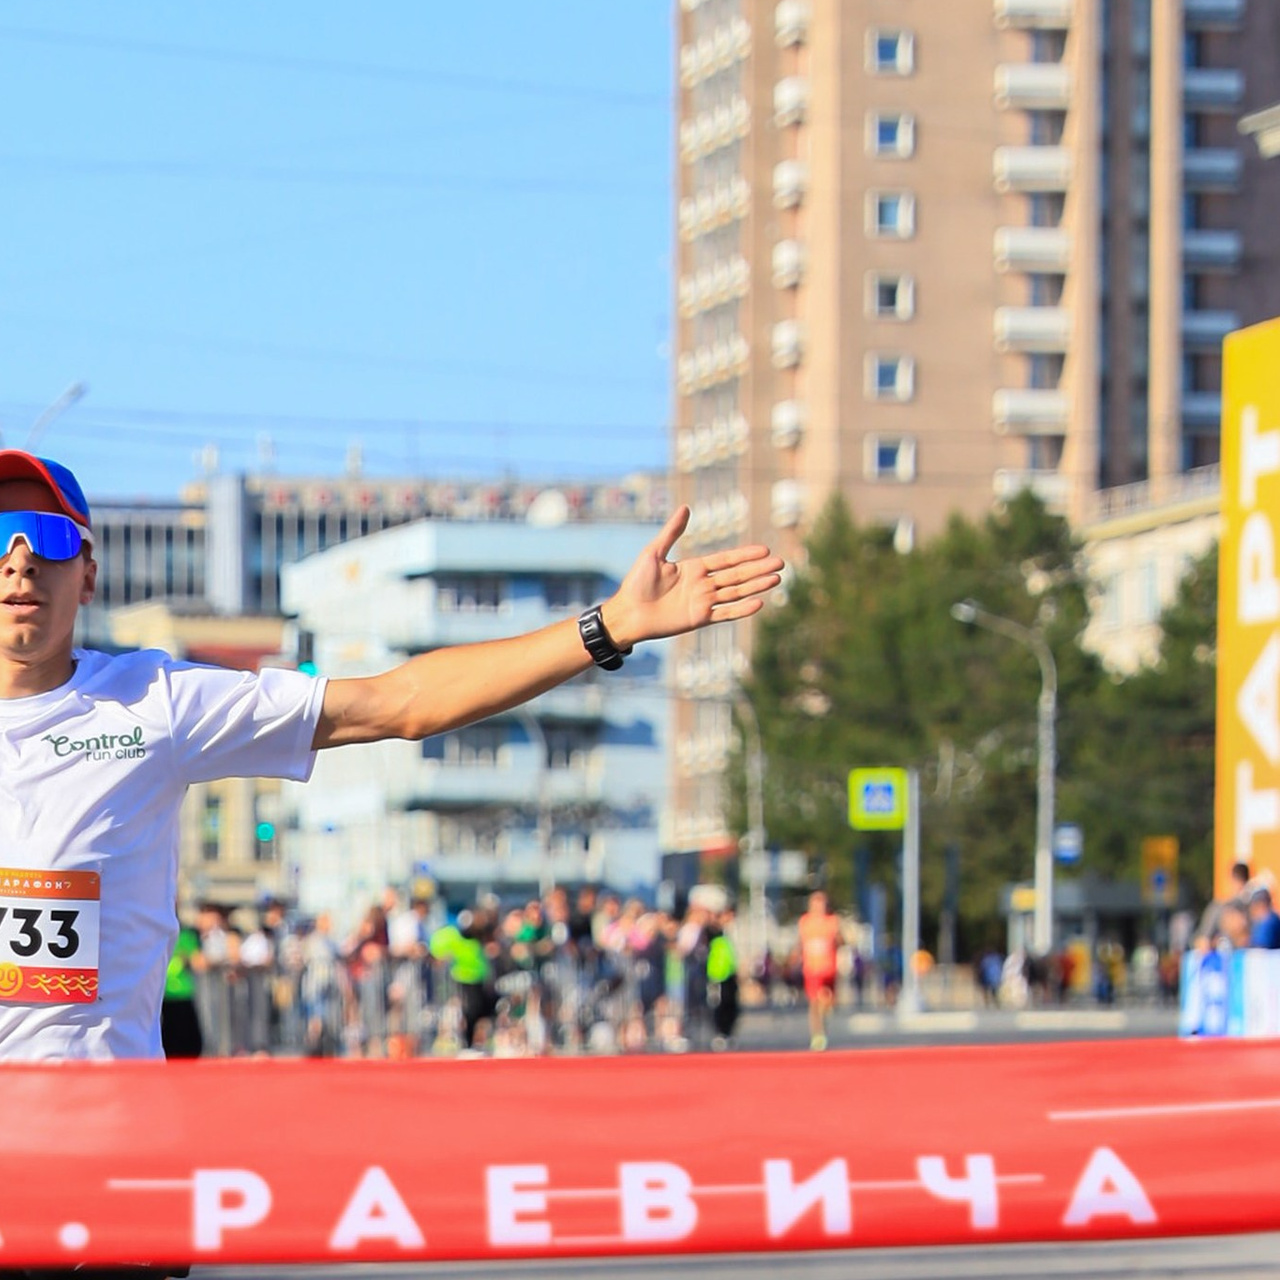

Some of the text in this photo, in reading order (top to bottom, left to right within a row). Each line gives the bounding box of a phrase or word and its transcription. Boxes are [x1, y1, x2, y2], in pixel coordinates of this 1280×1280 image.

[41, 726, 146, 757] Control
[86, 747, 146, 762] run club
[192, 1146, 1158, 1251] РАЕВИЧА
